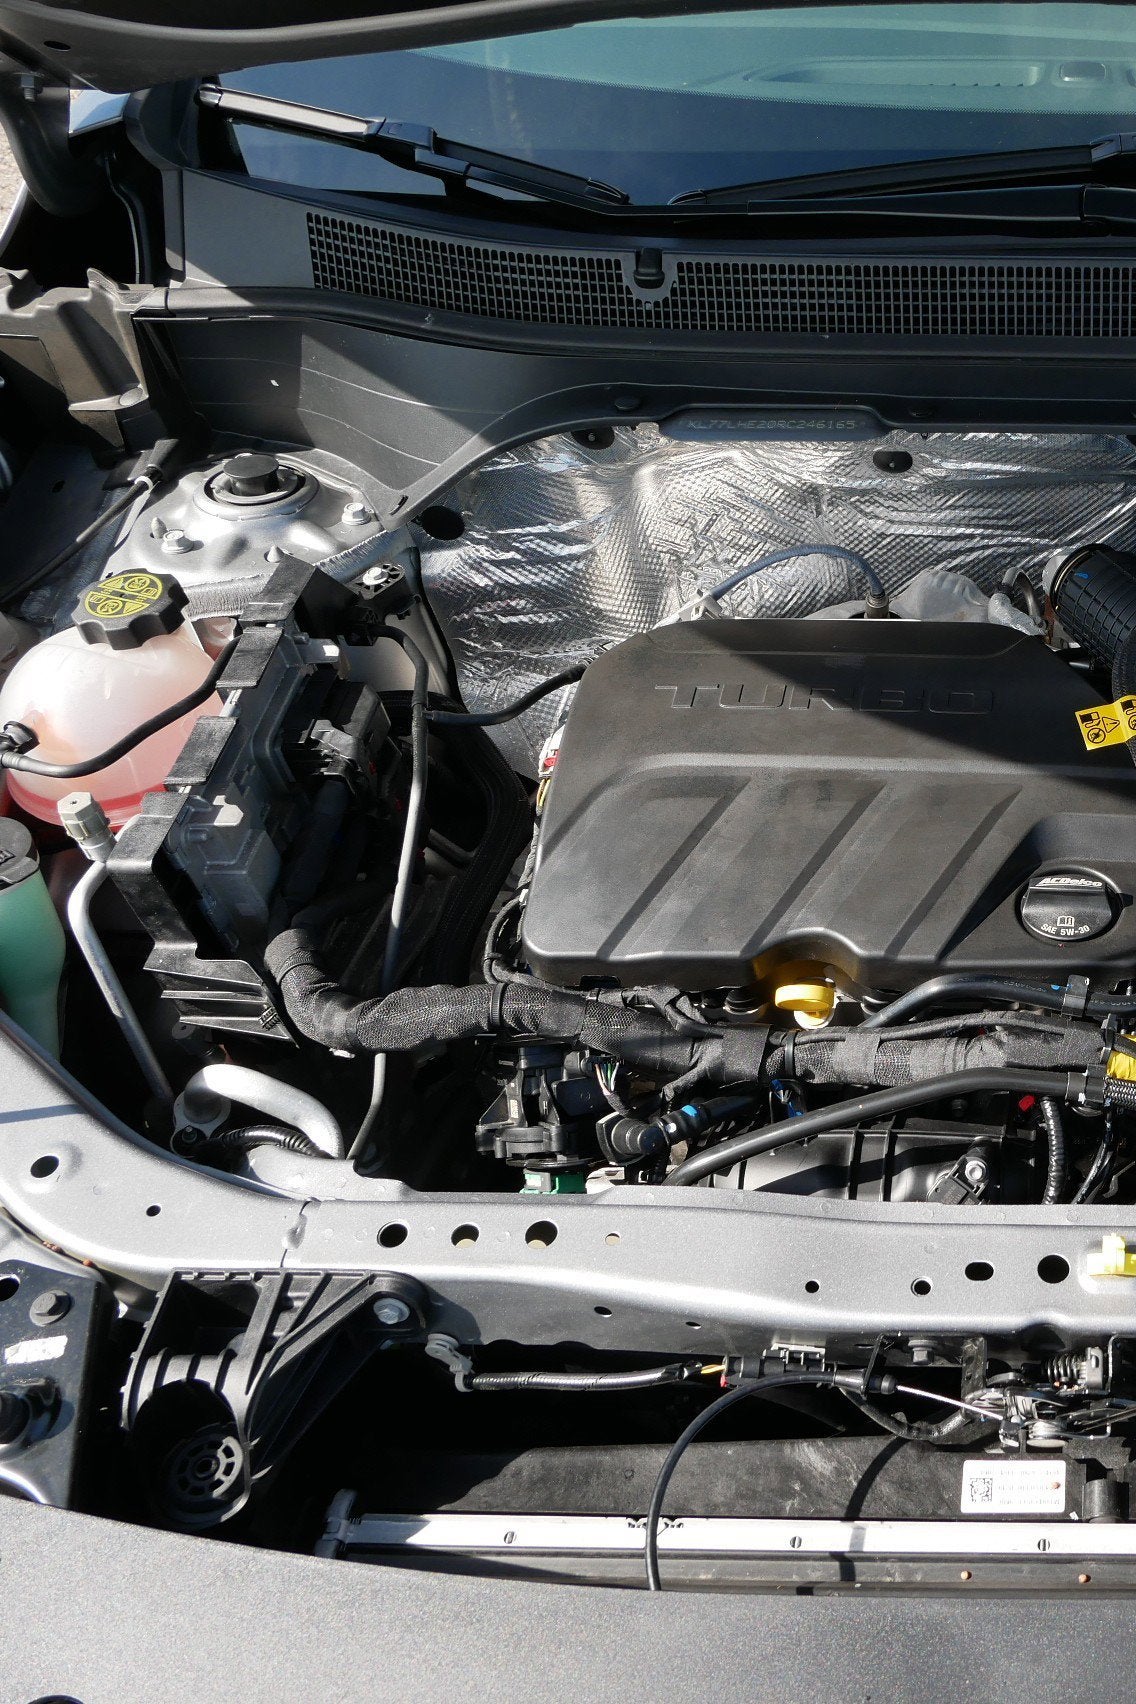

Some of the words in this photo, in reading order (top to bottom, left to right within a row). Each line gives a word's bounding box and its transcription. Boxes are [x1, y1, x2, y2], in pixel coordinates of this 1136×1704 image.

[654, 684, 995, 715] TURBO
[1041, 923, 1058, 934] SAE
[1060, 925, 1091, 936] 5W-30
